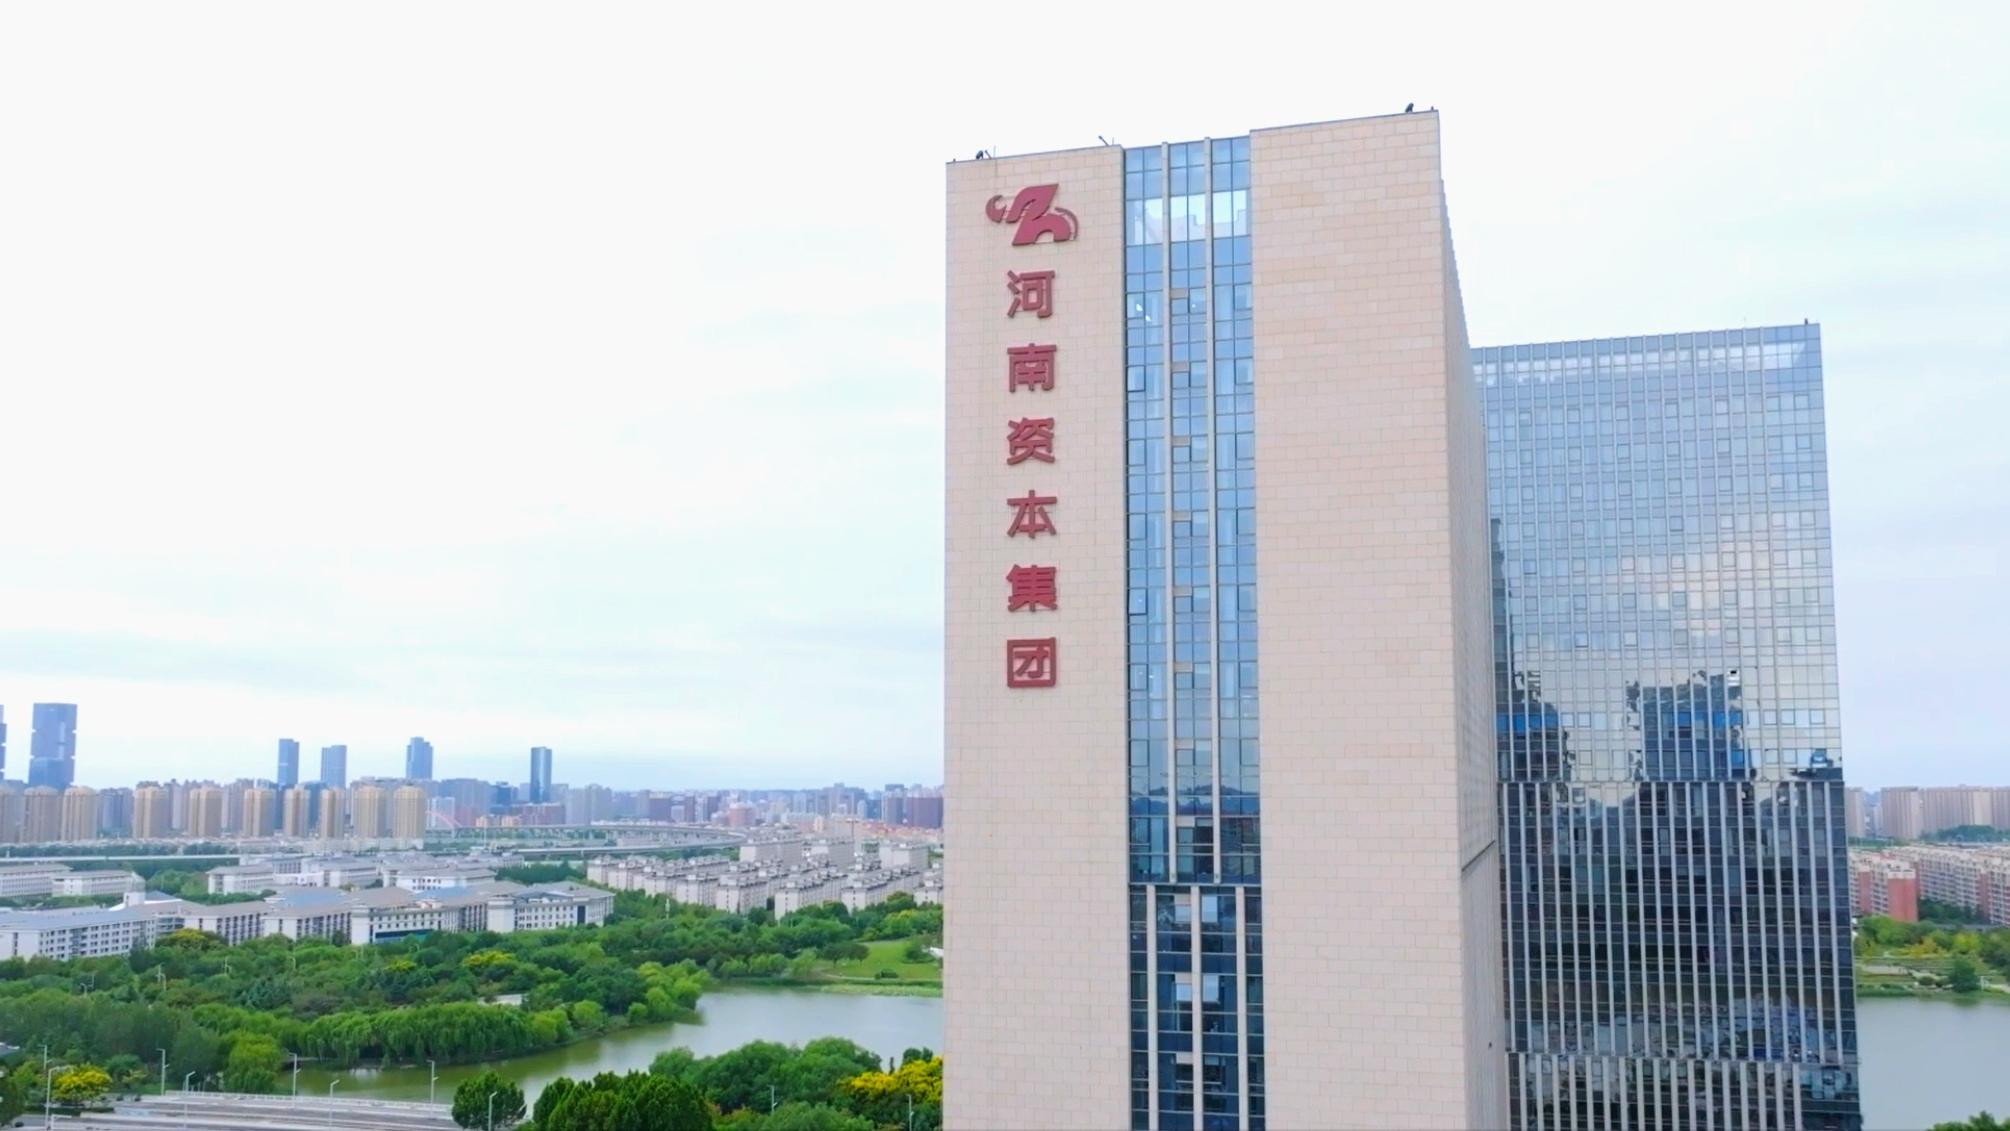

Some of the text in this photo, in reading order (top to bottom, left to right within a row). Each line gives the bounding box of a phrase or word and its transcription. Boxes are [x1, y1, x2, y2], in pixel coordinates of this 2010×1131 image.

[1007, 269, 1057, 688] 河南资本集团
